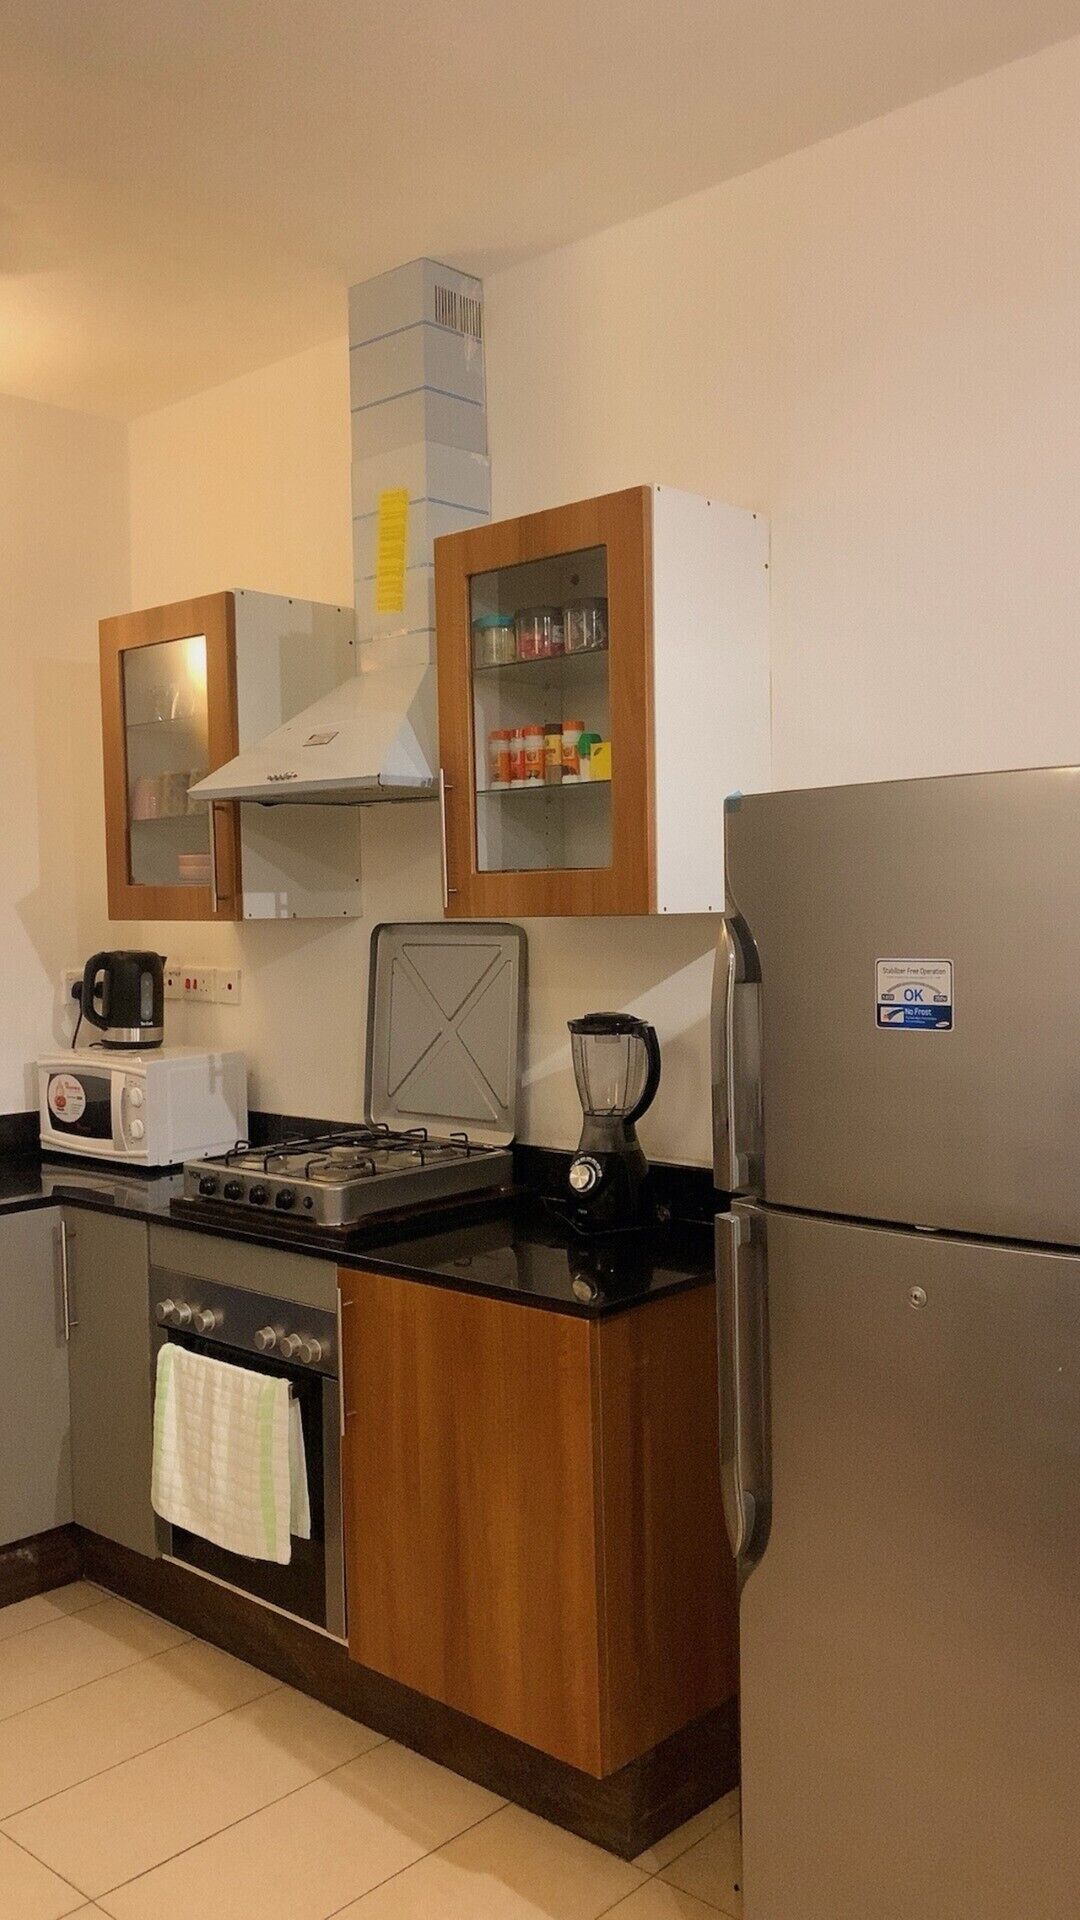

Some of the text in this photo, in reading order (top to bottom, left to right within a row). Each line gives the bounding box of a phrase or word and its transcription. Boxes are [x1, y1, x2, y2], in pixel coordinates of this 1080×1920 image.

[907, 967, 919, 975] Free
[920, 967, 946, 976] Operation
[904, 988, 923, 1002] OK
[914, 1008, 932, 1016] Frost
